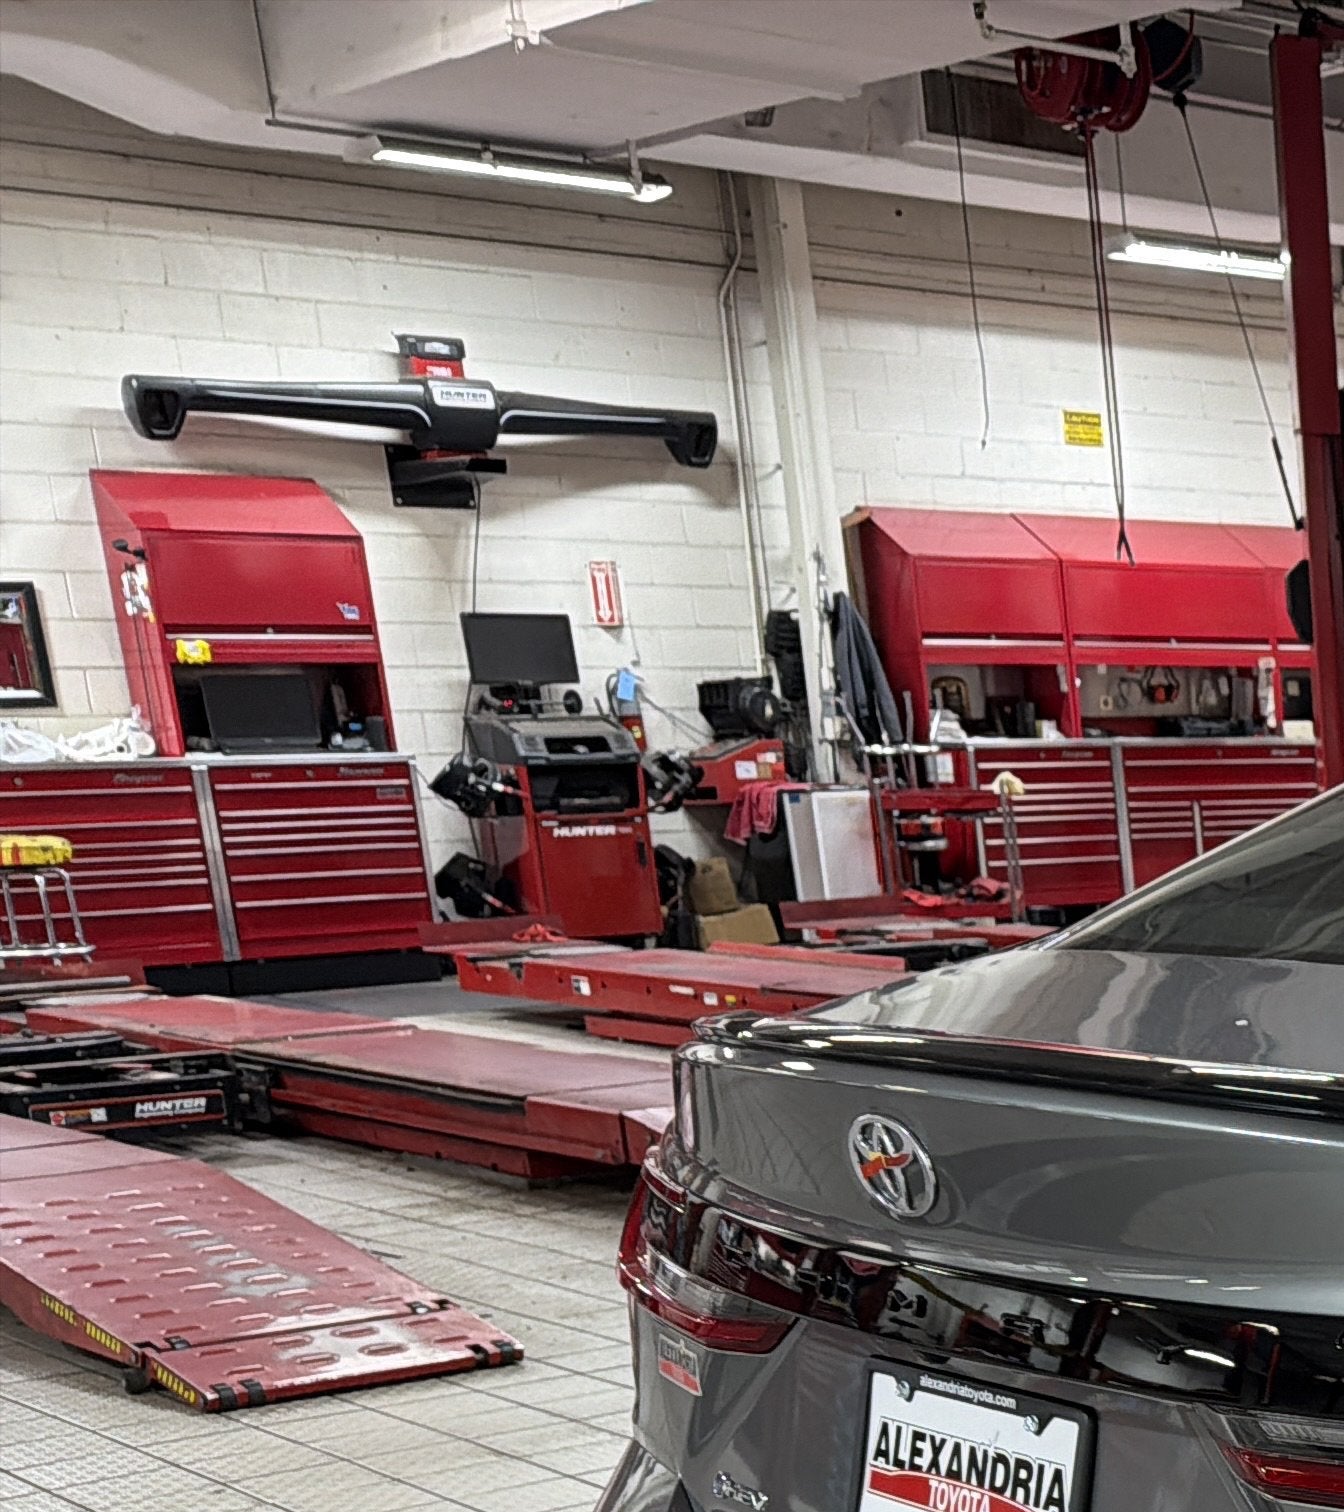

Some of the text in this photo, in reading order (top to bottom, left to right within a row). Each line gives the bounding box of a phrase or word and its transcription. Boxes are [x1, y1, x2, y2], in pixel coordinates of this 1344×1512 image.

[553, 825, 616, 838] HUNTER
[135, 1097, 207, 1113] HUNTER
[920, 1374, 1017, 1410] alexandriatoyota.com
